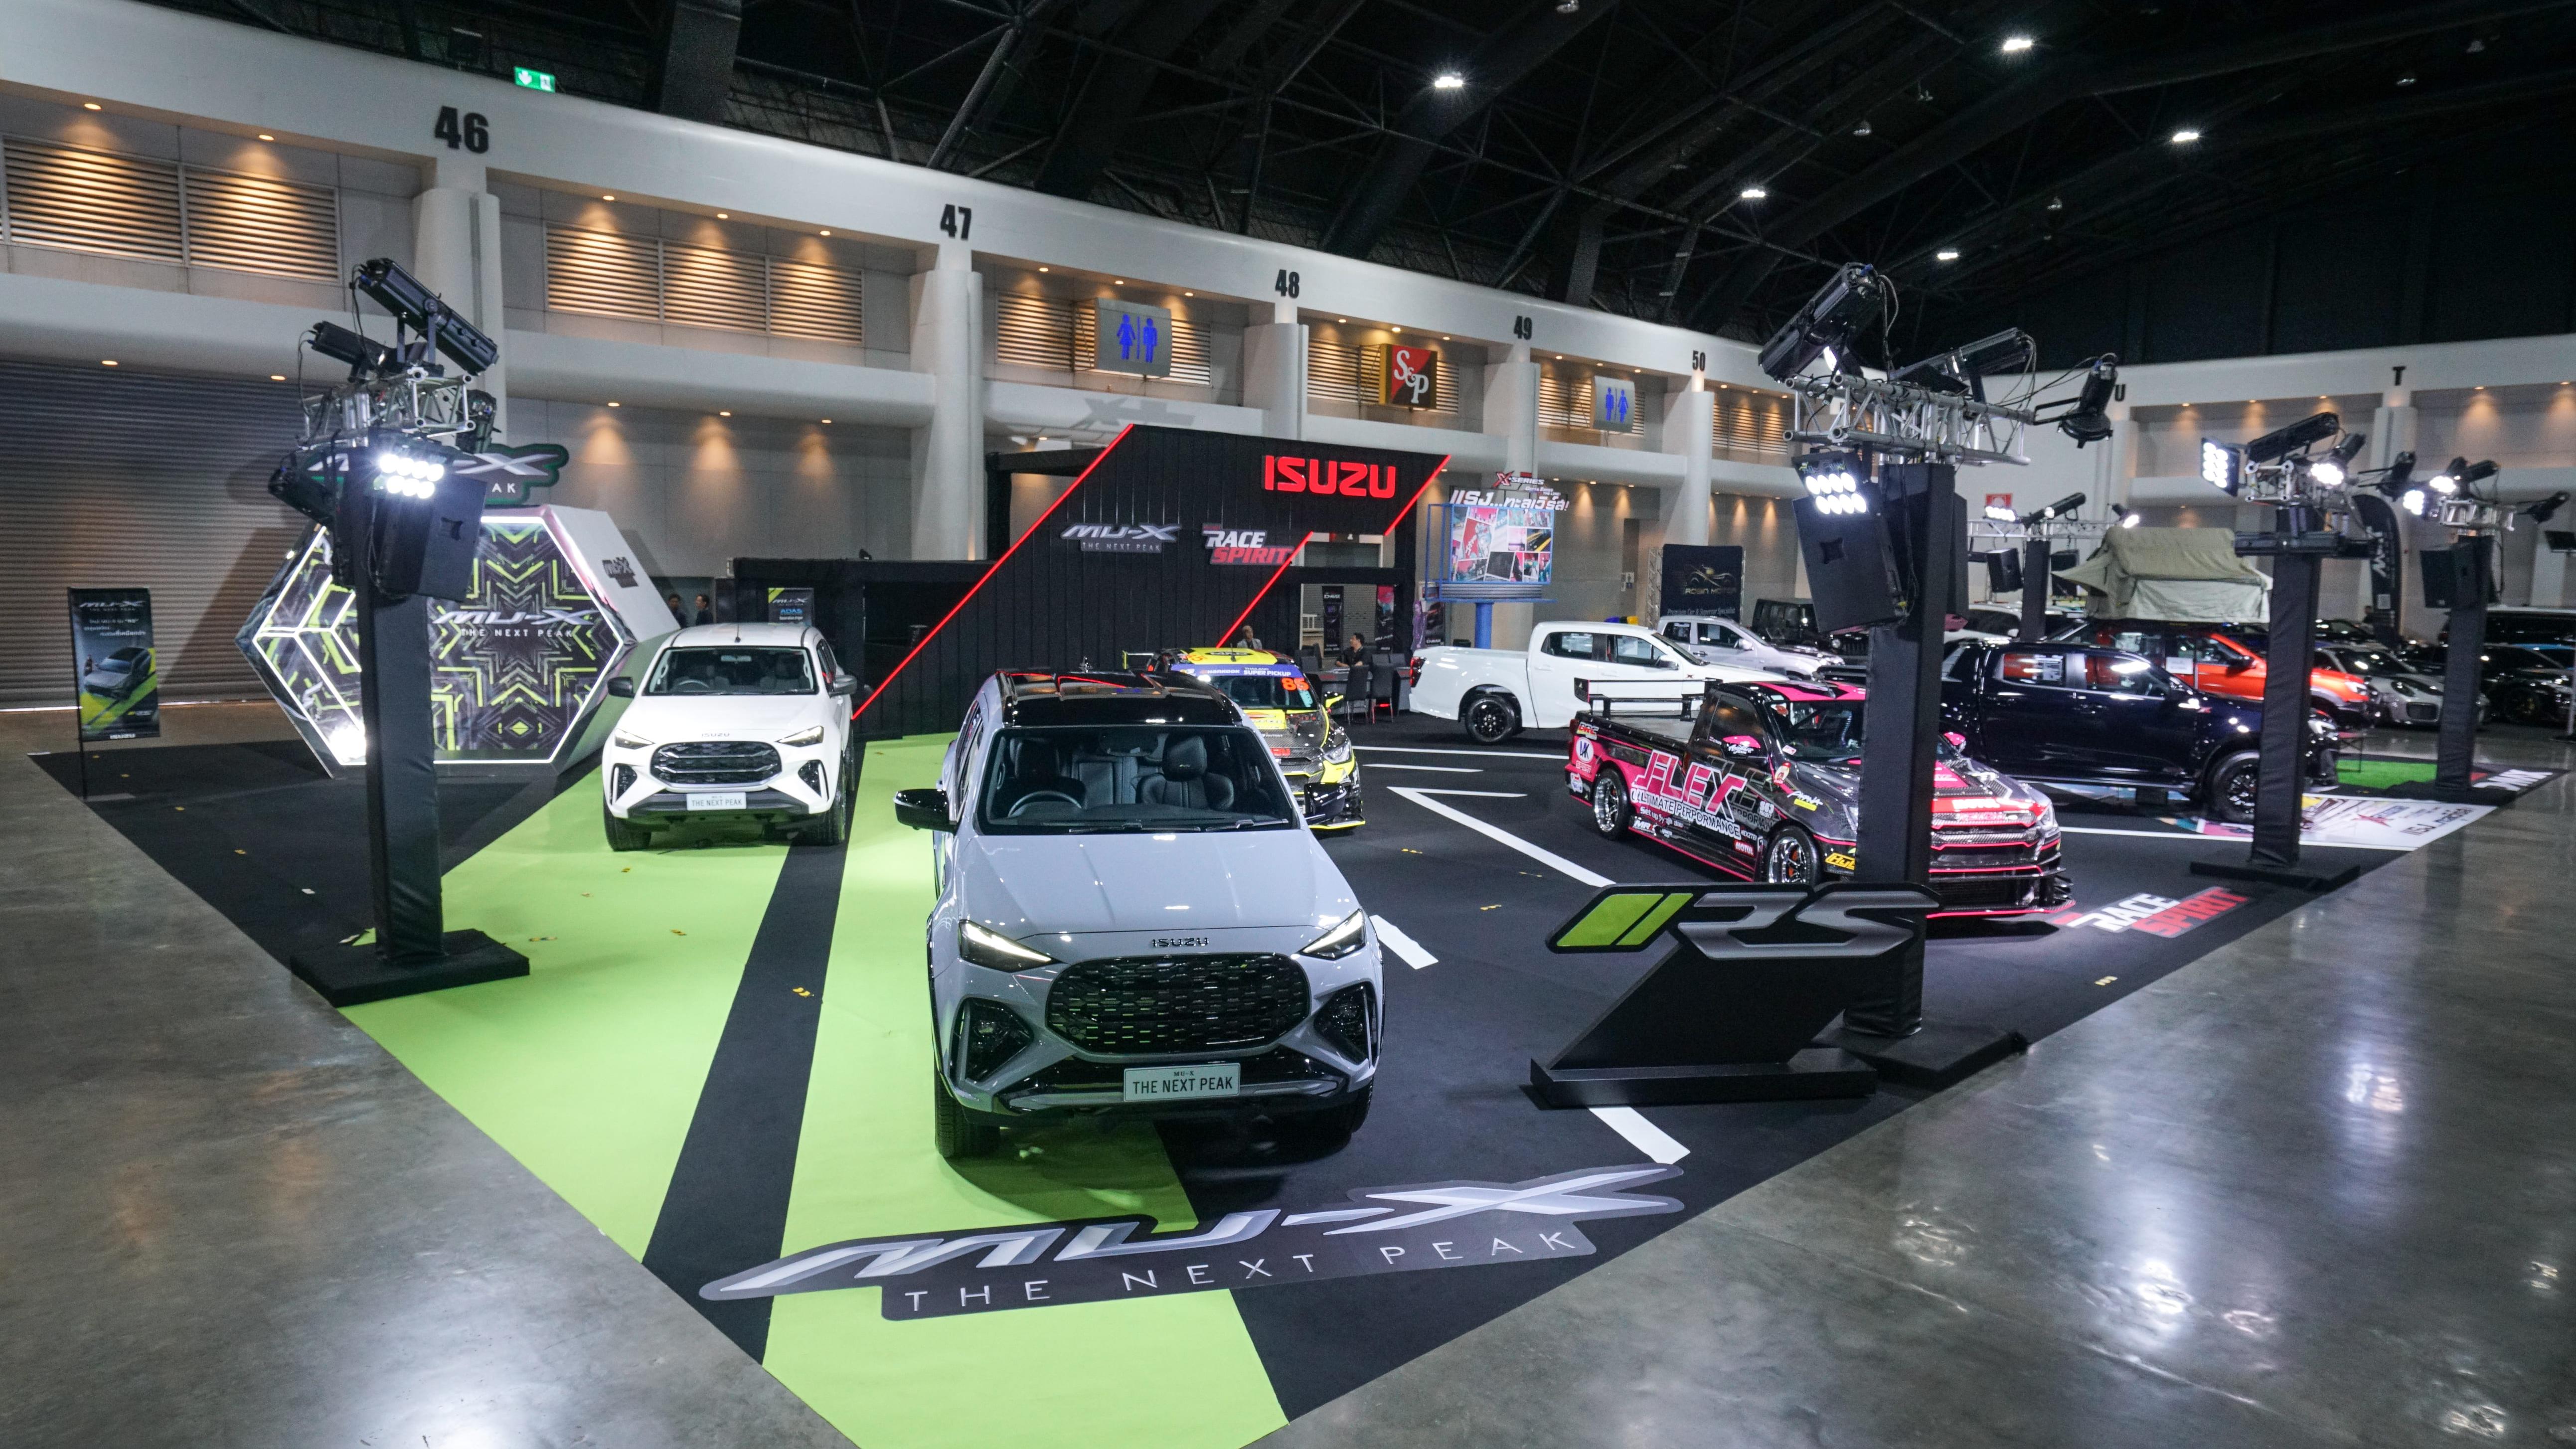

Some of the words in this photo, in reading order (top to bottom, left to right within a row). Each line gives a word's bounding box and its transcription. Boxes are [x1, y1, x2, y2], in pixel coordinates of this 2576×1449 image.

[434, 106, 489, 154] 46
[940, 204, 971, 240] 47
[1276, 269, 1299, 298] 48
[1514, 316, 1532, 340] 49
[1692, 350, 1706, 372] 50
[1394, 350, 1429, 404] S&P
[2393, 366, 2407, 386] T
[2114, 384, 2126, 402] U
[1265, 455, 1396, 498] ISUZU
[1061, 524, 1181, 541] MU-X
[1203, 530, 1266, 548] RACE
[1212, 547, 1293, 564] SPIRIT
[432, 609, 600, 626] MU-X
[461, 628, 485, 637] THE
[494, 629, 529, 638] NEXT
[538, 629, 573, 638] PEAK
[1630, 788, 1675, 815] ULTIMATE
[1674, 804, 1742, 840] PERFORMANCE
[1640, 806, 1651, 816] Set
[1735, 841, 1754, 856] MOTUL
[2067, 893, 2181, 932] RACE
[2131, 887, 2248, 936] SPIRIT
[1152, 937, 1209, 948] ISUZU
[1132, 1080, 1158, 1095] THE
[1162, 1078, 1196, 1093] NEXT
[1200, 1076, 1233, 1091] PEAK
[904, 1280, 1051, 1311] THE
[1122, 1253, 1316, 1291] NEXT
[1379, 1232, 1576, 1265] PEAK
